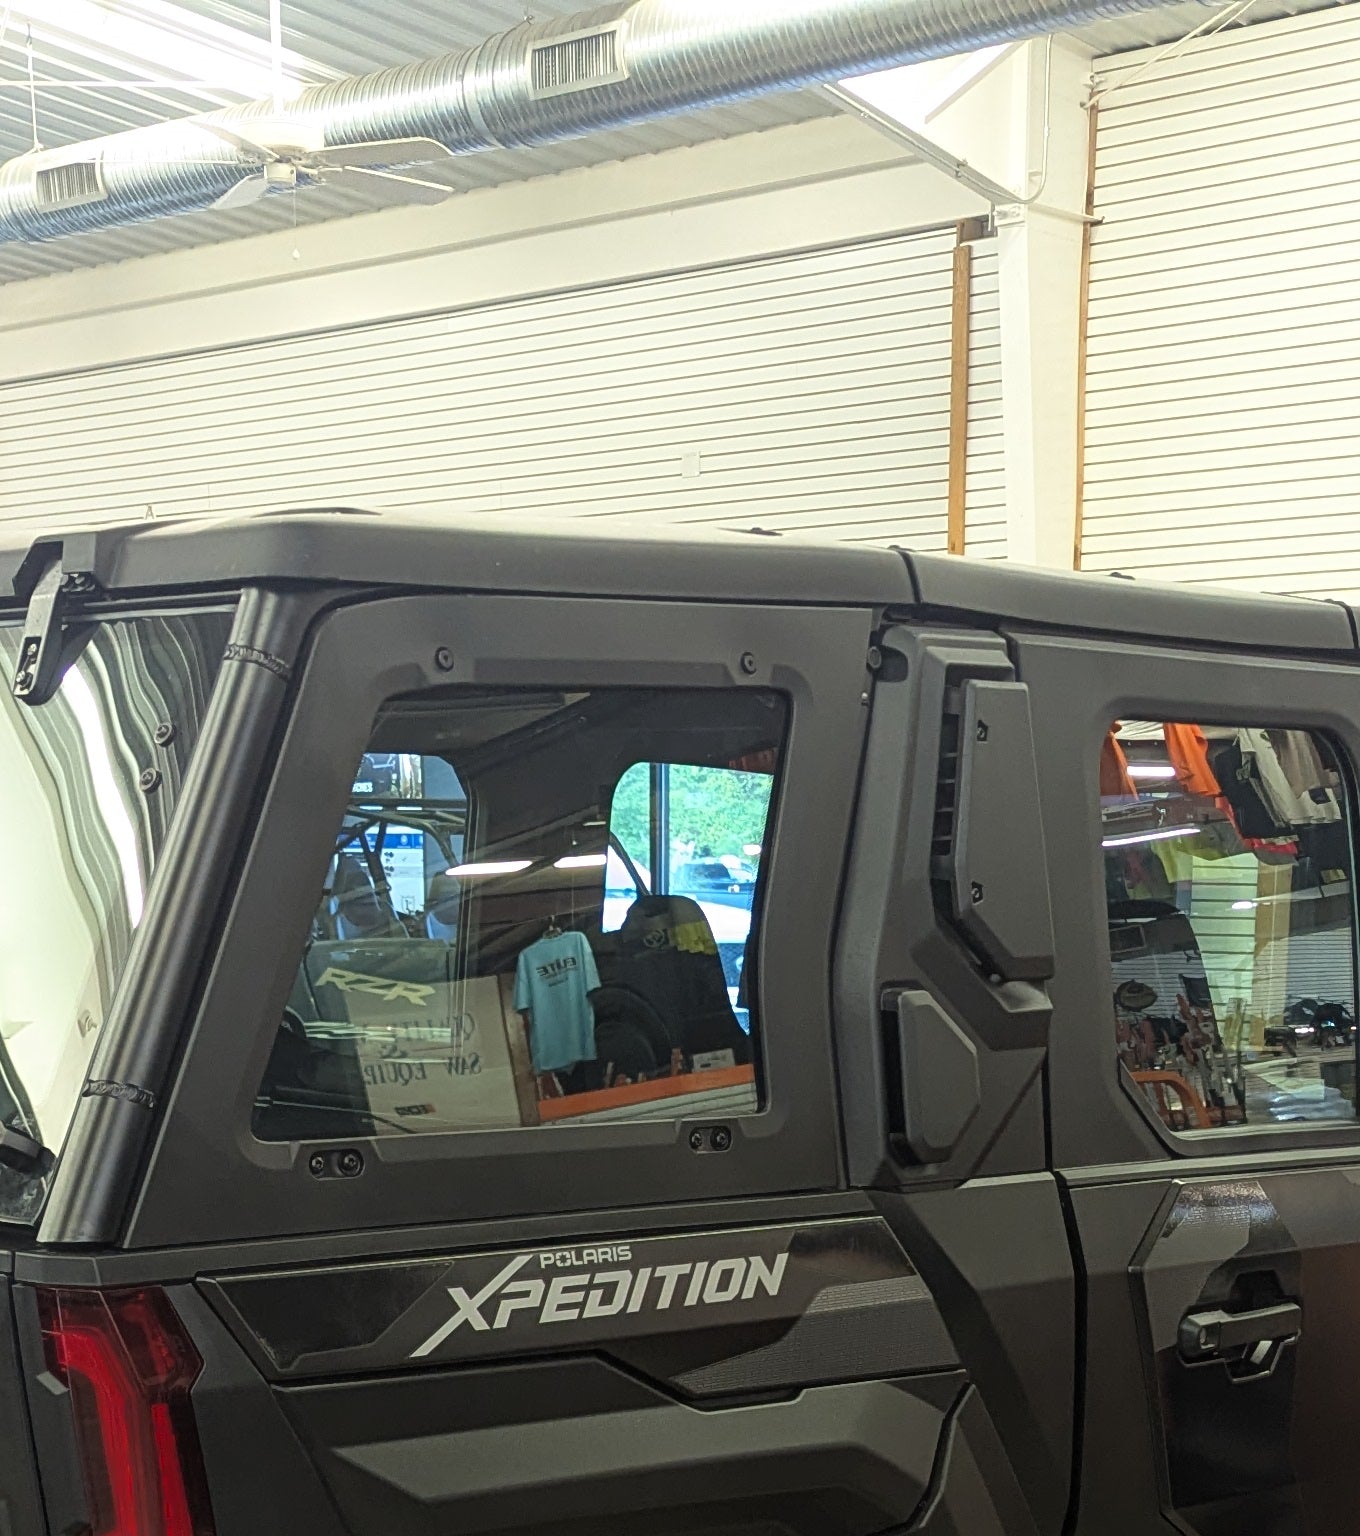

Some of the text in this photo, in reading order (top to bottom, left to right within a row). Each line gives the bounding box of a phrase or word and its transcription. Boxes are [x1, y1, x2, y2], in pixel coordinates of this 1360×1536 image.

[314, 966, 436, 1007] RZR
[540, 1245, 632, 1269] POLARIS
[409, 1252, 789, 1358] XPEDITION
